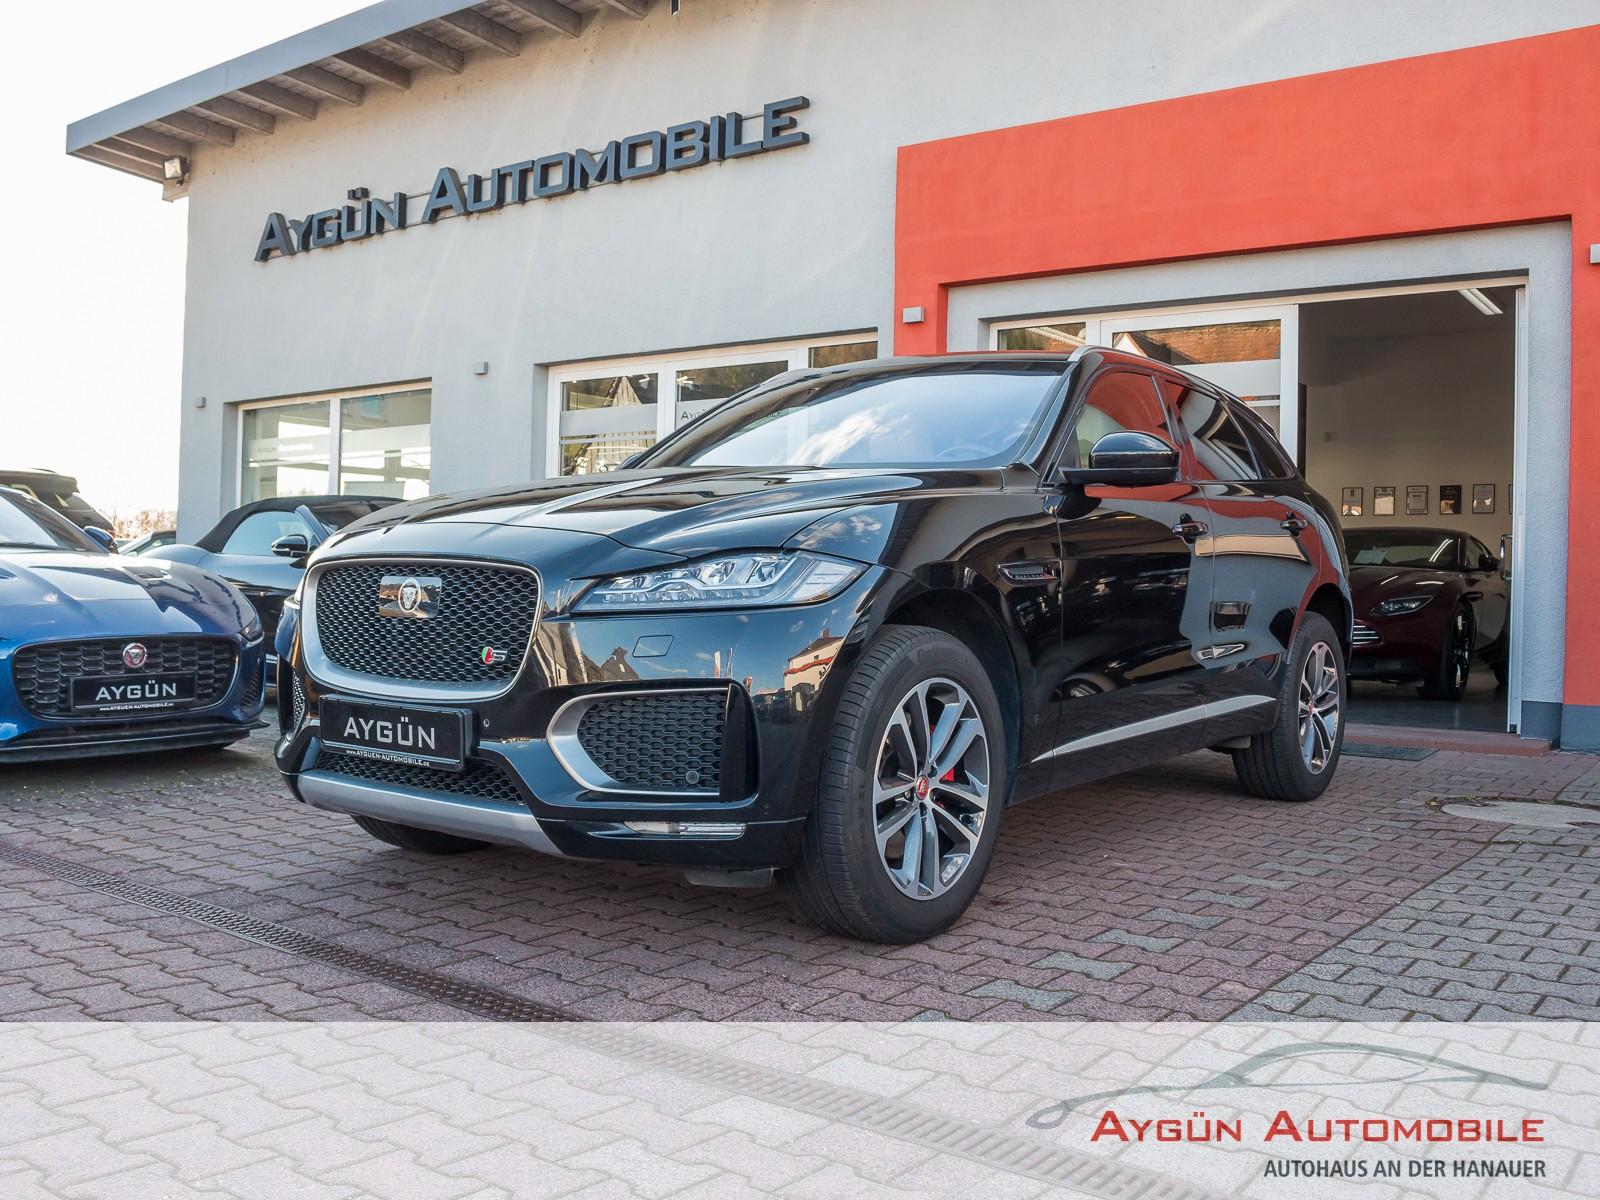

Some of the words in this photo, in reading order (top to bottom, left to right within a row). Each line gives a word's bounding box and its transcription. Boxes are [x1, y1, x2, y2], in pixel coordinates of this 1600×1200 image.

[254, 186, 407, 262] AYGÜN
[422, 95, 810, 225] AUTOMOBILE
[95, 679, 177, 701] AYGÜN
[343, 716, 436, 750] AYGÜN
